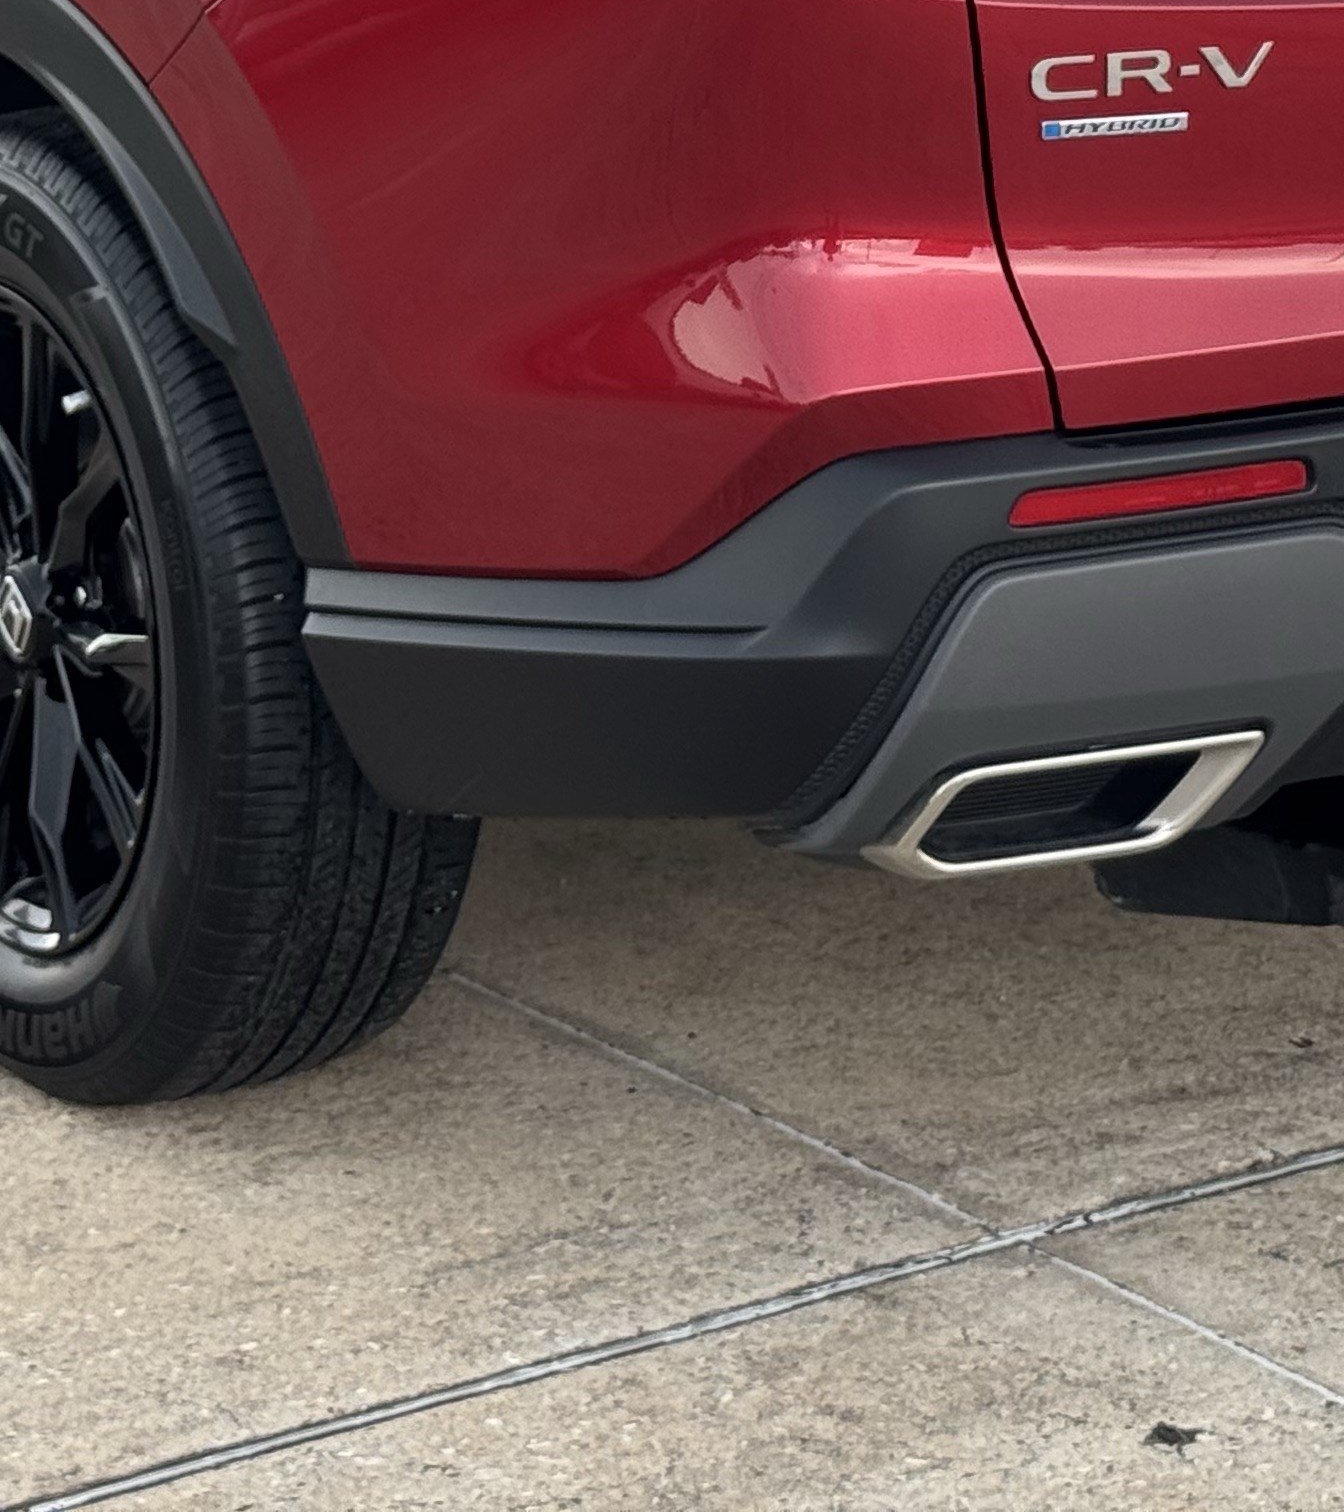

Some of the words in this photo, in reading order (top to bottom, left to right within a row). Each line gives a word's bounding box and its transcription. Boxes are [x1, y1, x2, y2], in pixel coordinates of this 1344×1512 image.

[1029, 40, 1276, 102] CR-V
[1063, 116, 1181, 136] HYBRID
[3, 211, 45, 260] GT
